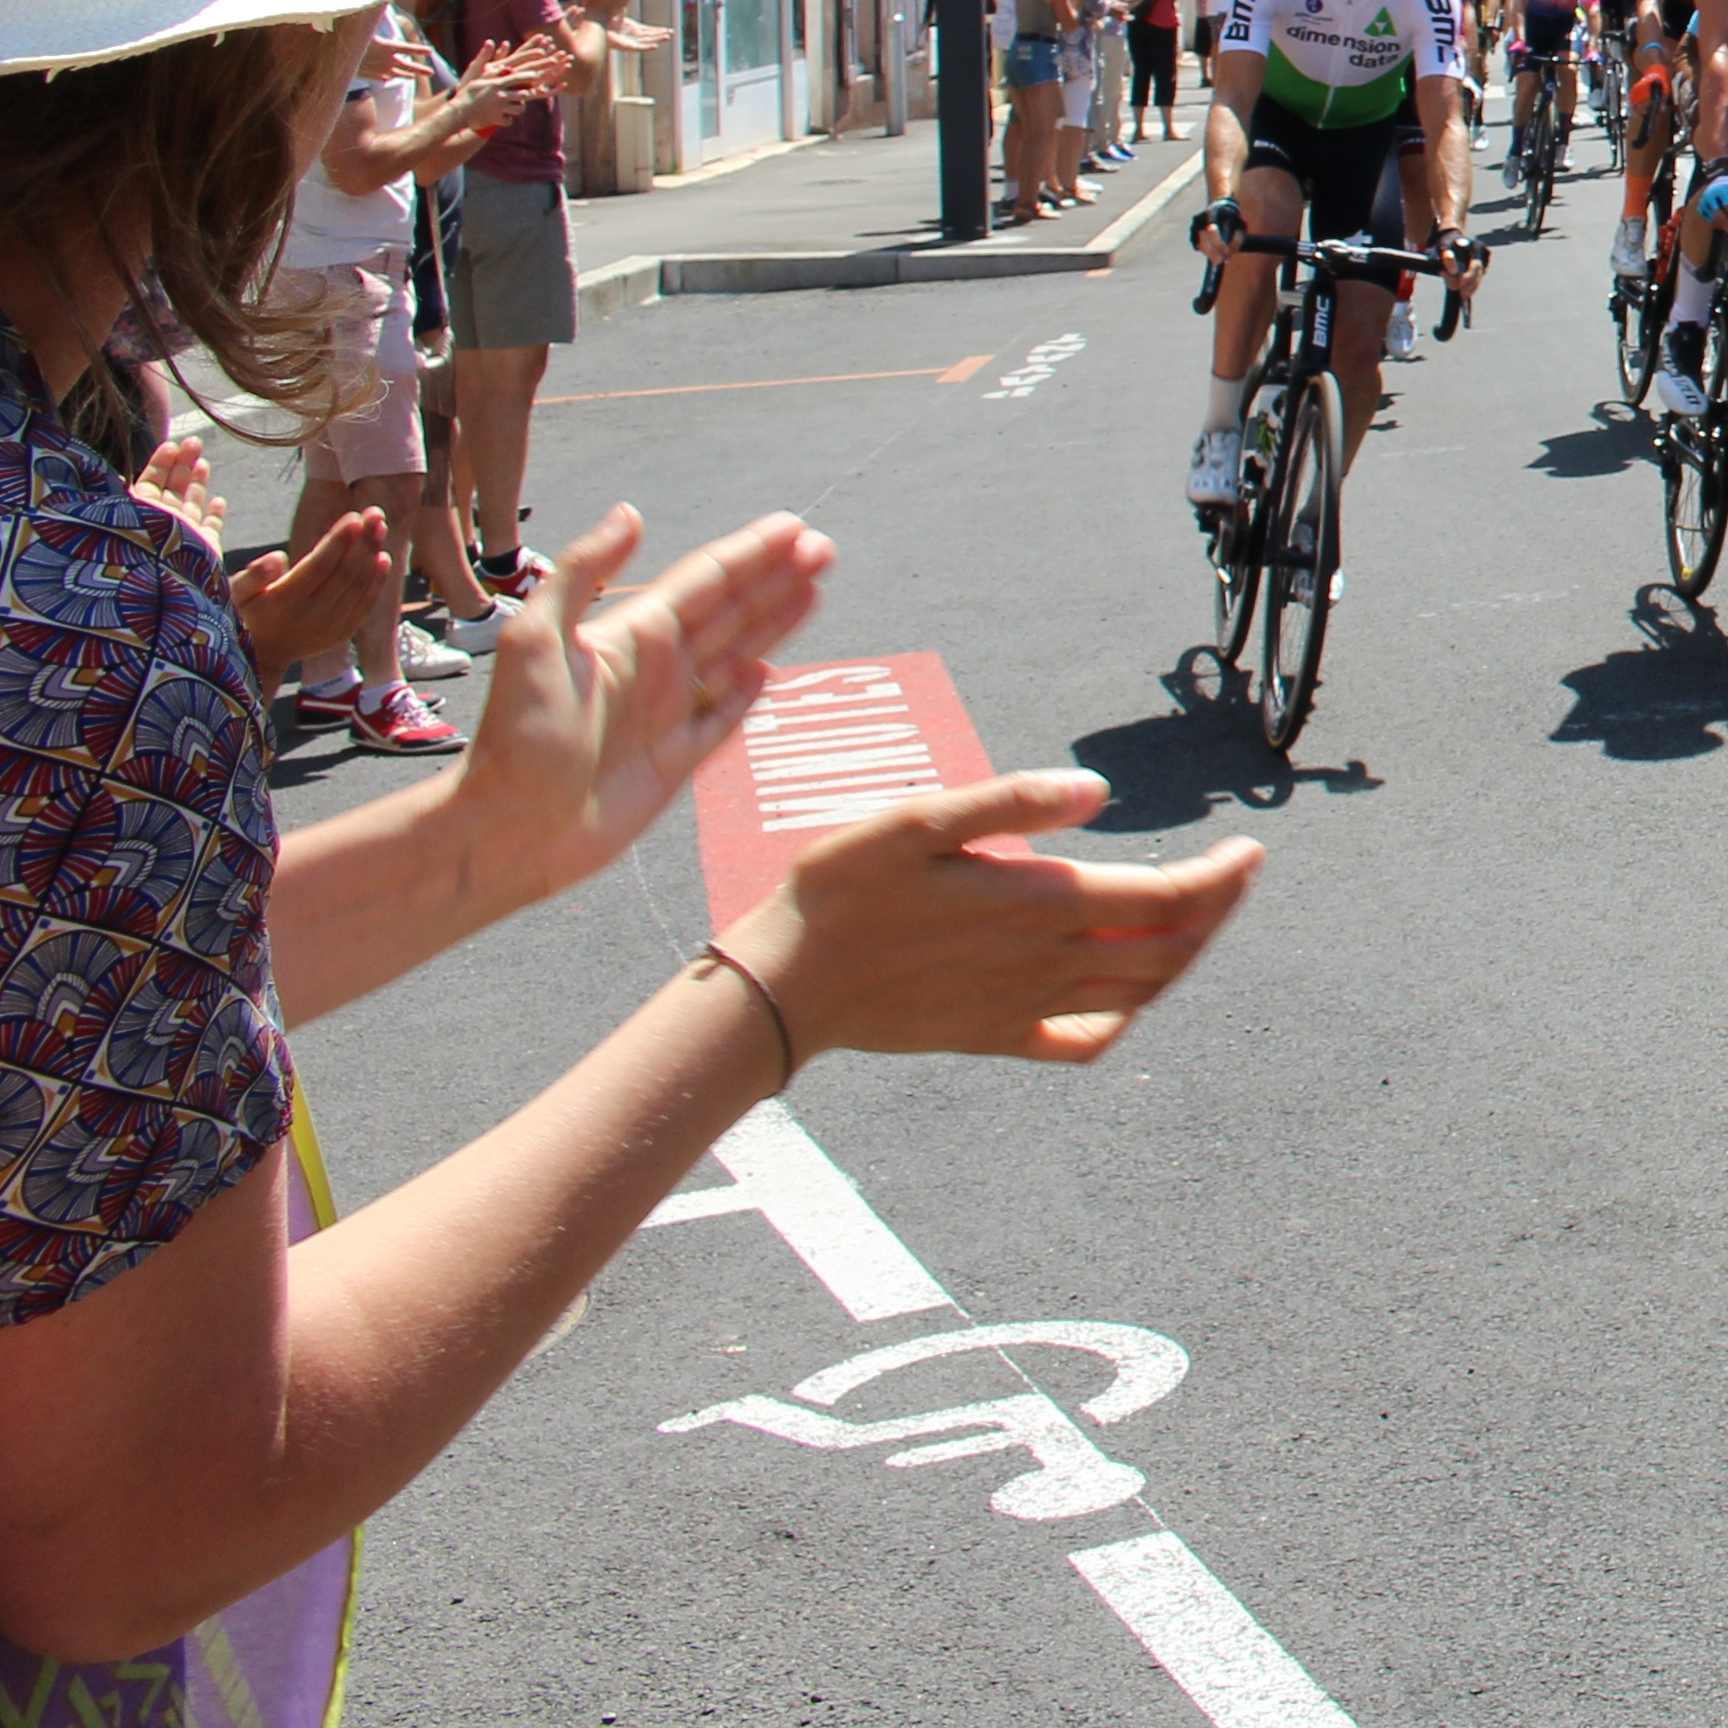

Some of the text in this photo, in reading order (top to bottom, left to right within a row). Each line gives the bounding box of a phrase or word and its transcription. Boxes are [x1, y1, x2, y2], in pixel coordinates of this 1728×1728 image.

[1286, 26, 1400, 54] dimension
[1349, 54, 1399, 69] data
[1312, 295, 1330, 348] BMC
